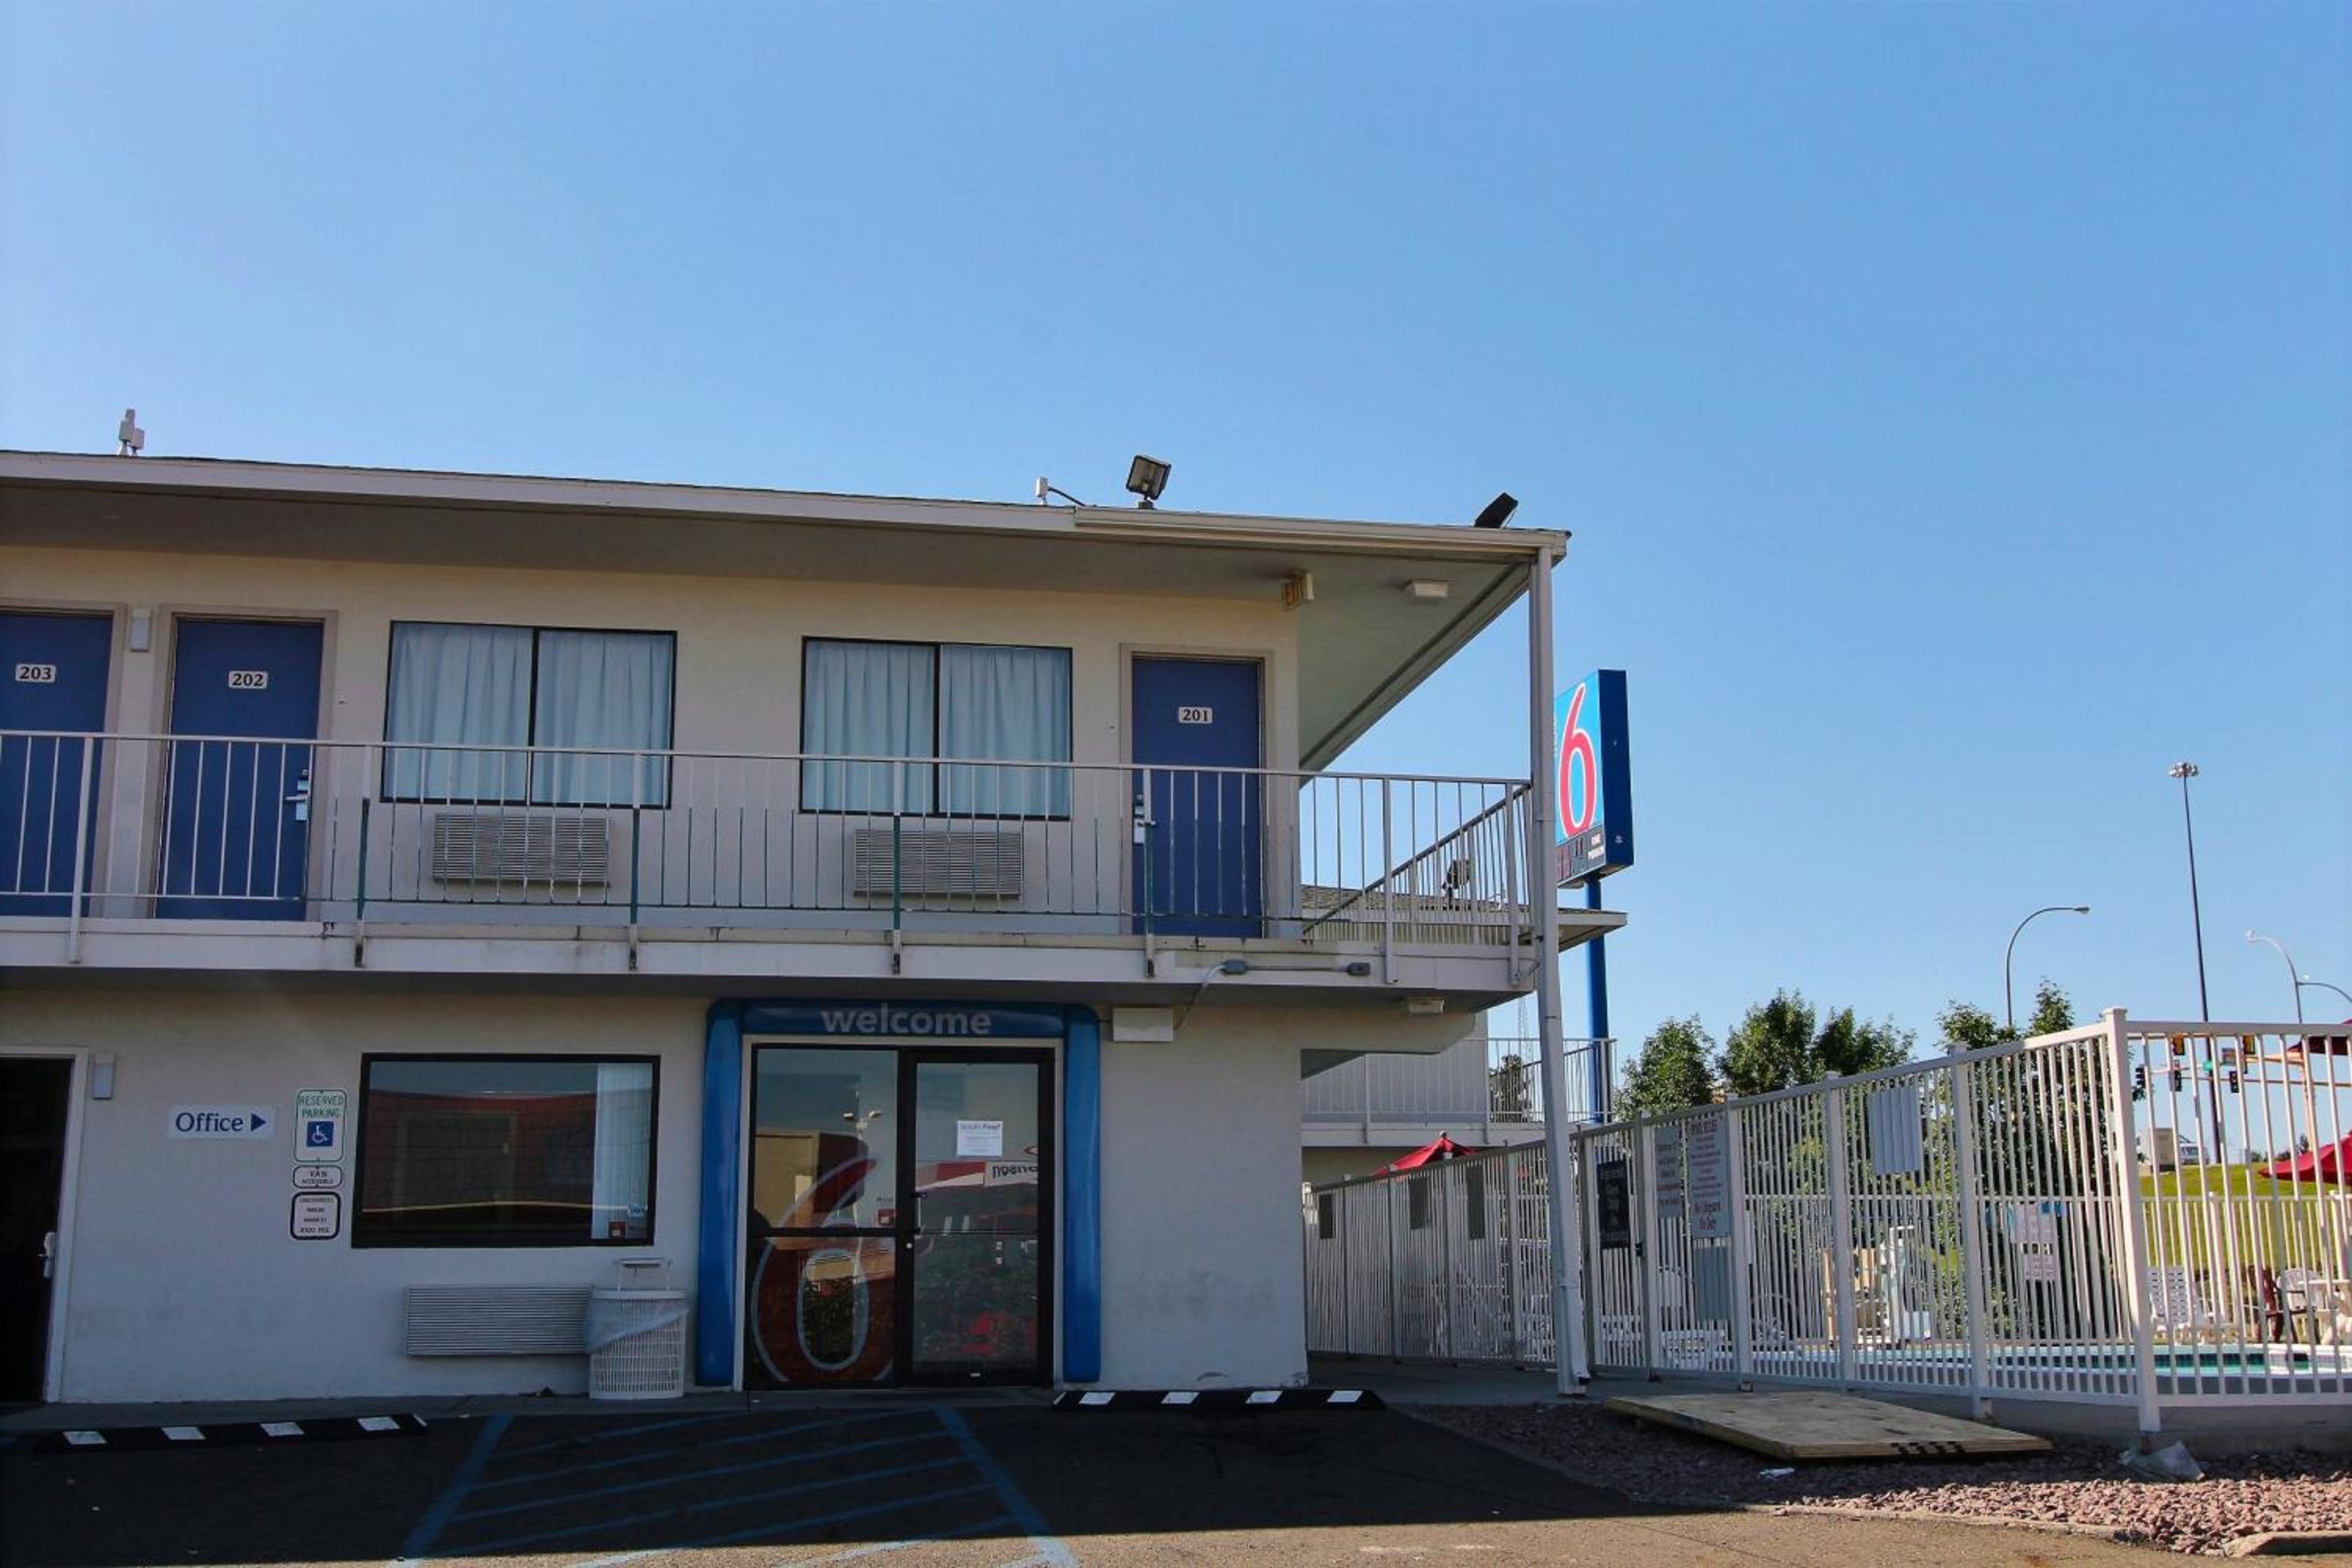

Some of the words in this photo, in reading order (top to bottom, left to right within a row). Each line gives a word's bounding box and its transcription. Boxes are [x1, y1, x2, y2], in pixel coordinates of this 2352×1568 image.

[20, 666, 51, 680] 203
[232, 673, 263, 687] 202
[1183, 709, 1208, 721] 201
[1559, 681, 1597, 837] 6
[820, 1002, 992, 1034] welcome
[299, 1095, 343, 1105] RESERVED
[302, 1107, 340, 1118] PARKING
[176, 1112, 244, 1131] Office
